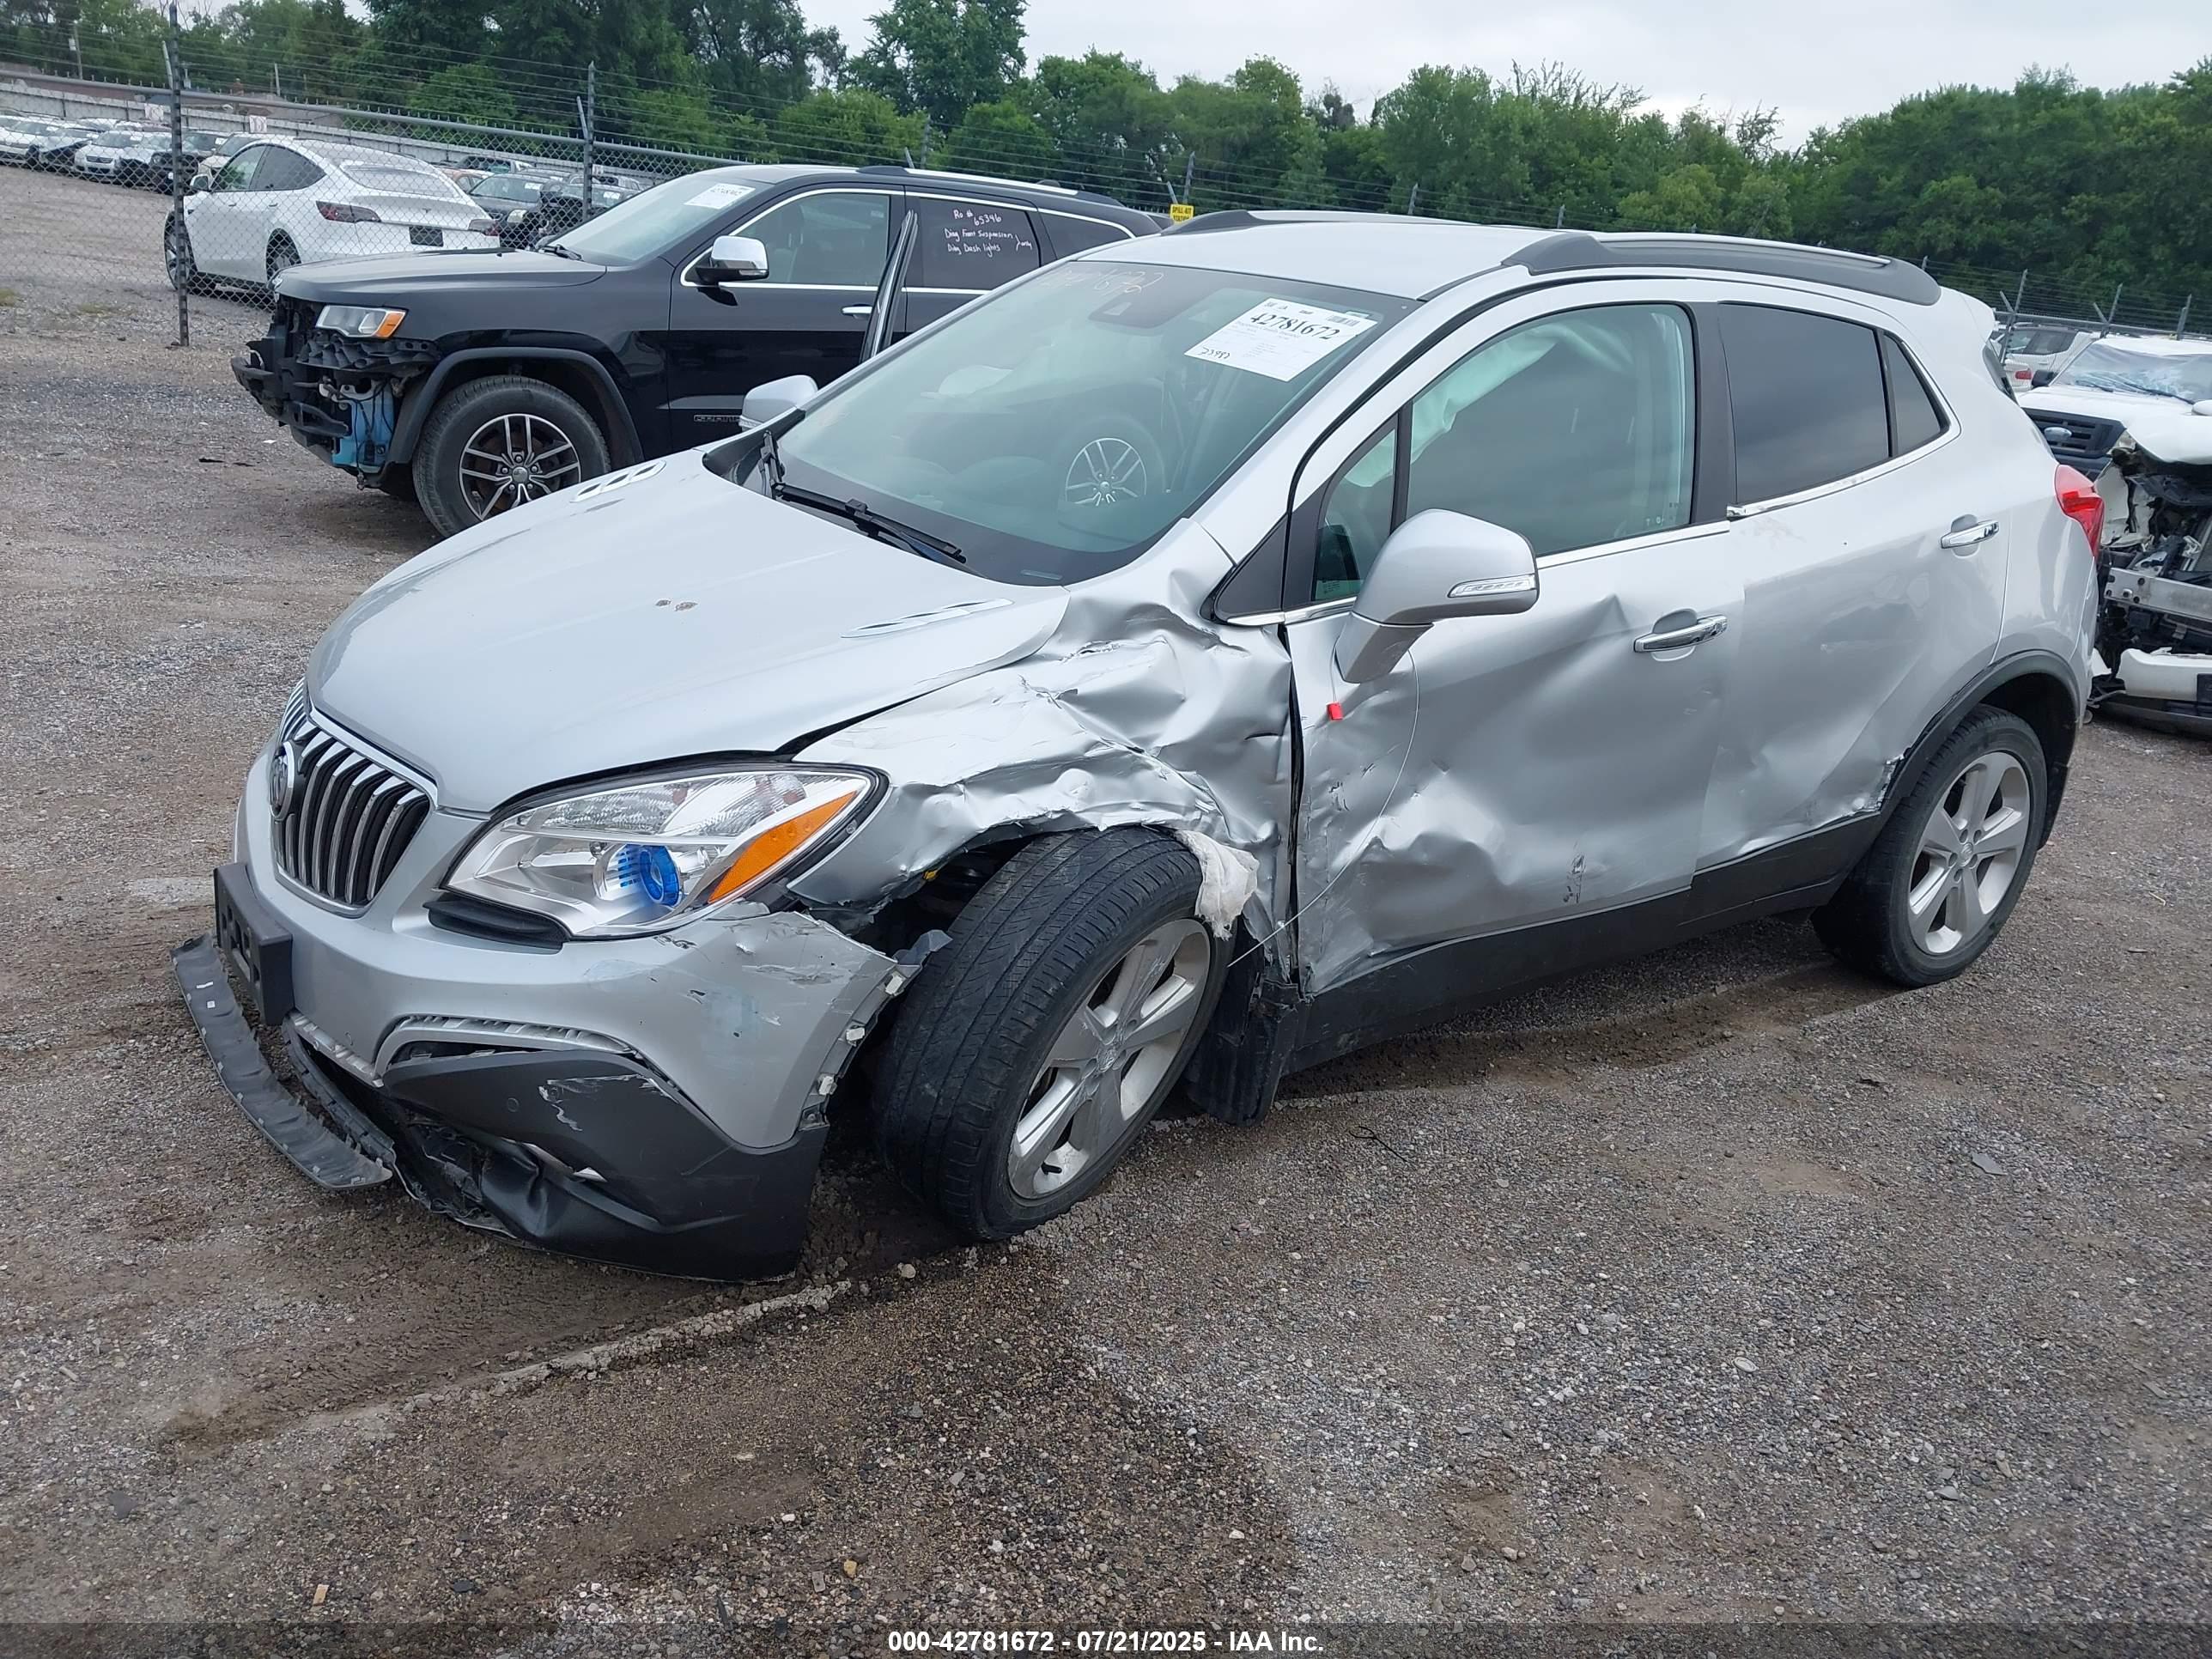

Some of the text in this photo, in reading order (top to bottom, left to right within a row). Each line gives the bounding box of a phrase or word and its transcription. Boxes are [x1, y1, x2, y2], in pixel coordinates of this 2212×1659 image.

[974, 213, 1002, 227] 65346
[963, 242, 981, 253] Dash
[982, 242, 1001, 258] lights
[1250, 313, 1340, 340] 42781672
